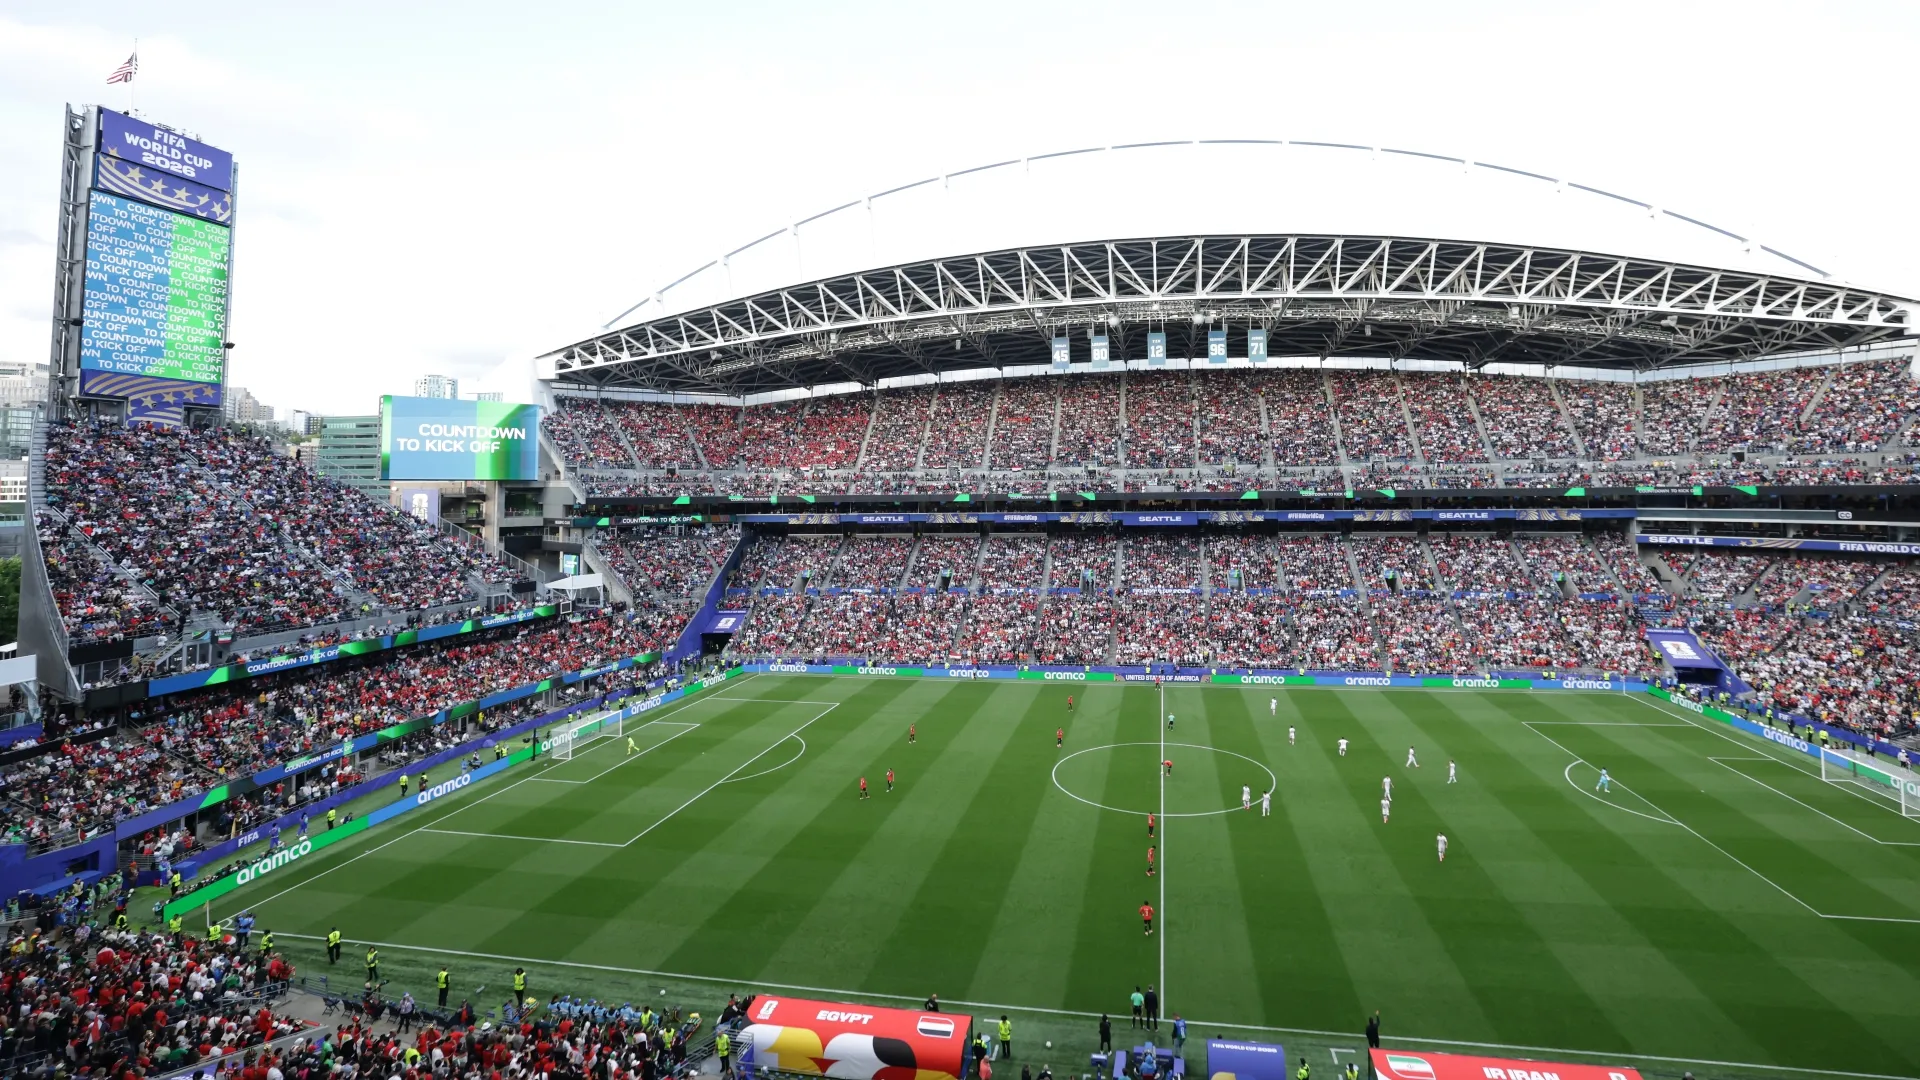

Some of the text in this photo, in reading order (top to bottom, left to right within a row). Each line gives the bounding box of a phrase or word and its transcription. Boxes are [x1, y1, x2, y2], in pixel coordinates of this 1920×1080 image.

[154, 129, 186, 150] FIFA
[124, 132, 212, 170] WORLD CUP
[142, 152, 196, 178] 2026
[114, 208, 128, 219] TO
[131, 214, 155, 226] KICK
[159, 221, 179, 231] OFF
[193, 230, 206, 239] TO
[127, 204, 195, 228] COUNTDOWN
[94, 223, 116, 234] OFF
[132, 232, 146, 242] TO
[150, 237, 173, 249] KICK
[177, 244, 196, 254] OFF
[210, 251, 221, 260] TO
[146, 227, 212, 249] COUNTDOWN
[100, 253, 171, 275] COUNTDOWN
[114, 247, 136, 258] OFF
[151, 255, 165, 265] TO
[168, 260, 191, 271] KICK
[194, 265, 213, 275] OFF
[164, 250, 228, 270] COUNTDOWN
[86, 260, 100, 270] TO
[104, 264, 130, 276] KICK
[133, 270, 155, 281] OFF
[169, 278, 182, 286] TO
[184, 280, 206, 292] KICK
[119, 277, 188, 298] COUNTDOWN
[105, 283, 223, 313] TO KICK OFF TO KICK
[86, 300, 108, 310] OFF
[125, 306, 139, 315] TO
[142, 310, 166, 320] KICK
[169, 314, 189, 323] OFF
[202, 320, 215, 328] TO
[138, 300, 205, 318] COUNTDOWN
[105, 322, 128, 332] OFF
[144, 328, 158, 337] TO
[160, 331, 184, 341] KICK
[187, 335, 206, 344] OFF
[156, 321, 221, 338] COUNTDOWN
[91, 330, 165, 348] COUNTDOWN
[96, 340, 122, 351] KICK
[126, 344, 148, 354] OFF
[162, 349, 176, 358] TO
[178, 352, 200, 361] KICK
[204, 356, 222, 364] OFF
[1053, 350, 1068, 362] 45
[1093, 348, 1108, 360] 80
[1150, 345, 1163, 358] 12
[1210, 344, 1225, 356] 96
[1251, 342, 1264, 354] 71
[112, 352, 183, 368] COUNTDOWN
[98, 360, 217, 380] TO KICK OFF TO KICK
[418, 424, 526, 440] COUNTDOWN
[397, 438, 500, 454] TO KICK OFF
[1649, 536, 1714, 544] SEATTLE
[1840, 543, 1865, 551] FIFA
[1865, 544, 1909, 553] WORLD
[247, 649, 340, 673] COUNTDOWN TO KICK OFF
[770, 664, 807, 673] aramco
[858, 666, 896, 676] aramco
[1044, 671, 1085, 680] aramco
[703, 672, 726, 688] aramco
[1241, 675, 1285, 685] aramco
[1345, 676, 1390, 686] aramco
[1452, 678, 1499, 688] aramco
[1563, 679, 1611, 690] aramco
[631, 697, 661, 714] aramco
[1670, 694, 1703, 714] aramco
[1763, 728, 1808, 752] aramco
[285, 755, 321, 772] COUNTDOWN
[418, 773, 471, 804] aramco
[238, 831, 259, 847] FIFA
[236, 840, 312, 884] aramco
[816, 1010, 873, 1024] EGYPT
[1482, 1067, 1560, 1080] IR IRAN
